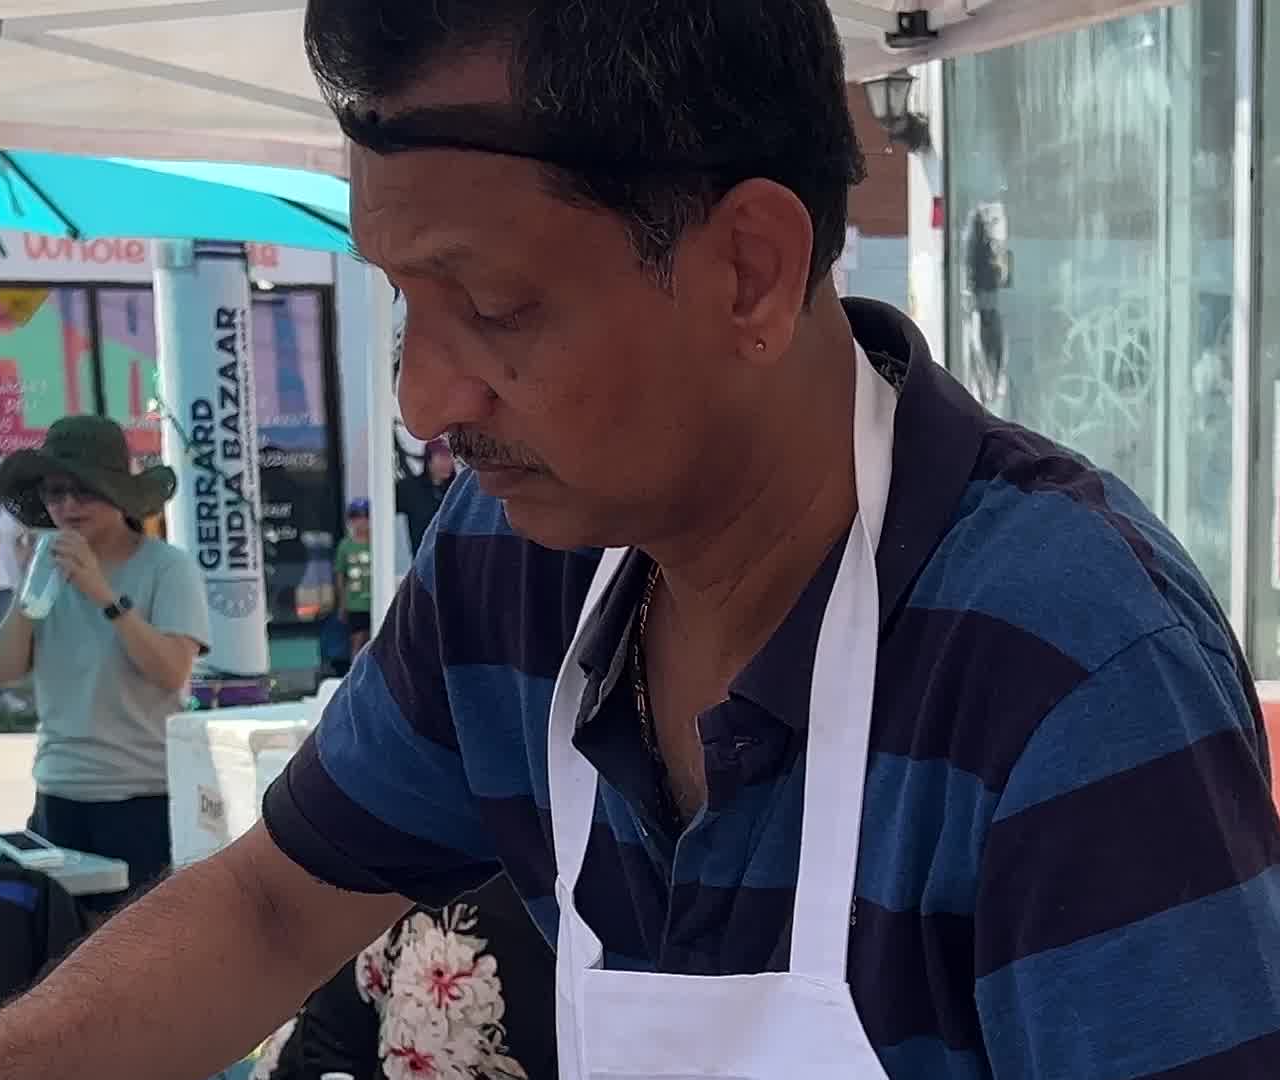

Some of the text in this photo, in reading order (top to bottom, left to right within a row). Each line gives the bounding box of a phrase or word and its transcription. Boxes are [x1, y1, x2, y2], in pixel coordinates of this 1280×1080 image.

[216, 306, 241, 460] BAZAAR
[191, 398, 221, 571] GERRARD
[224, 472, 250, 571] INDIA
